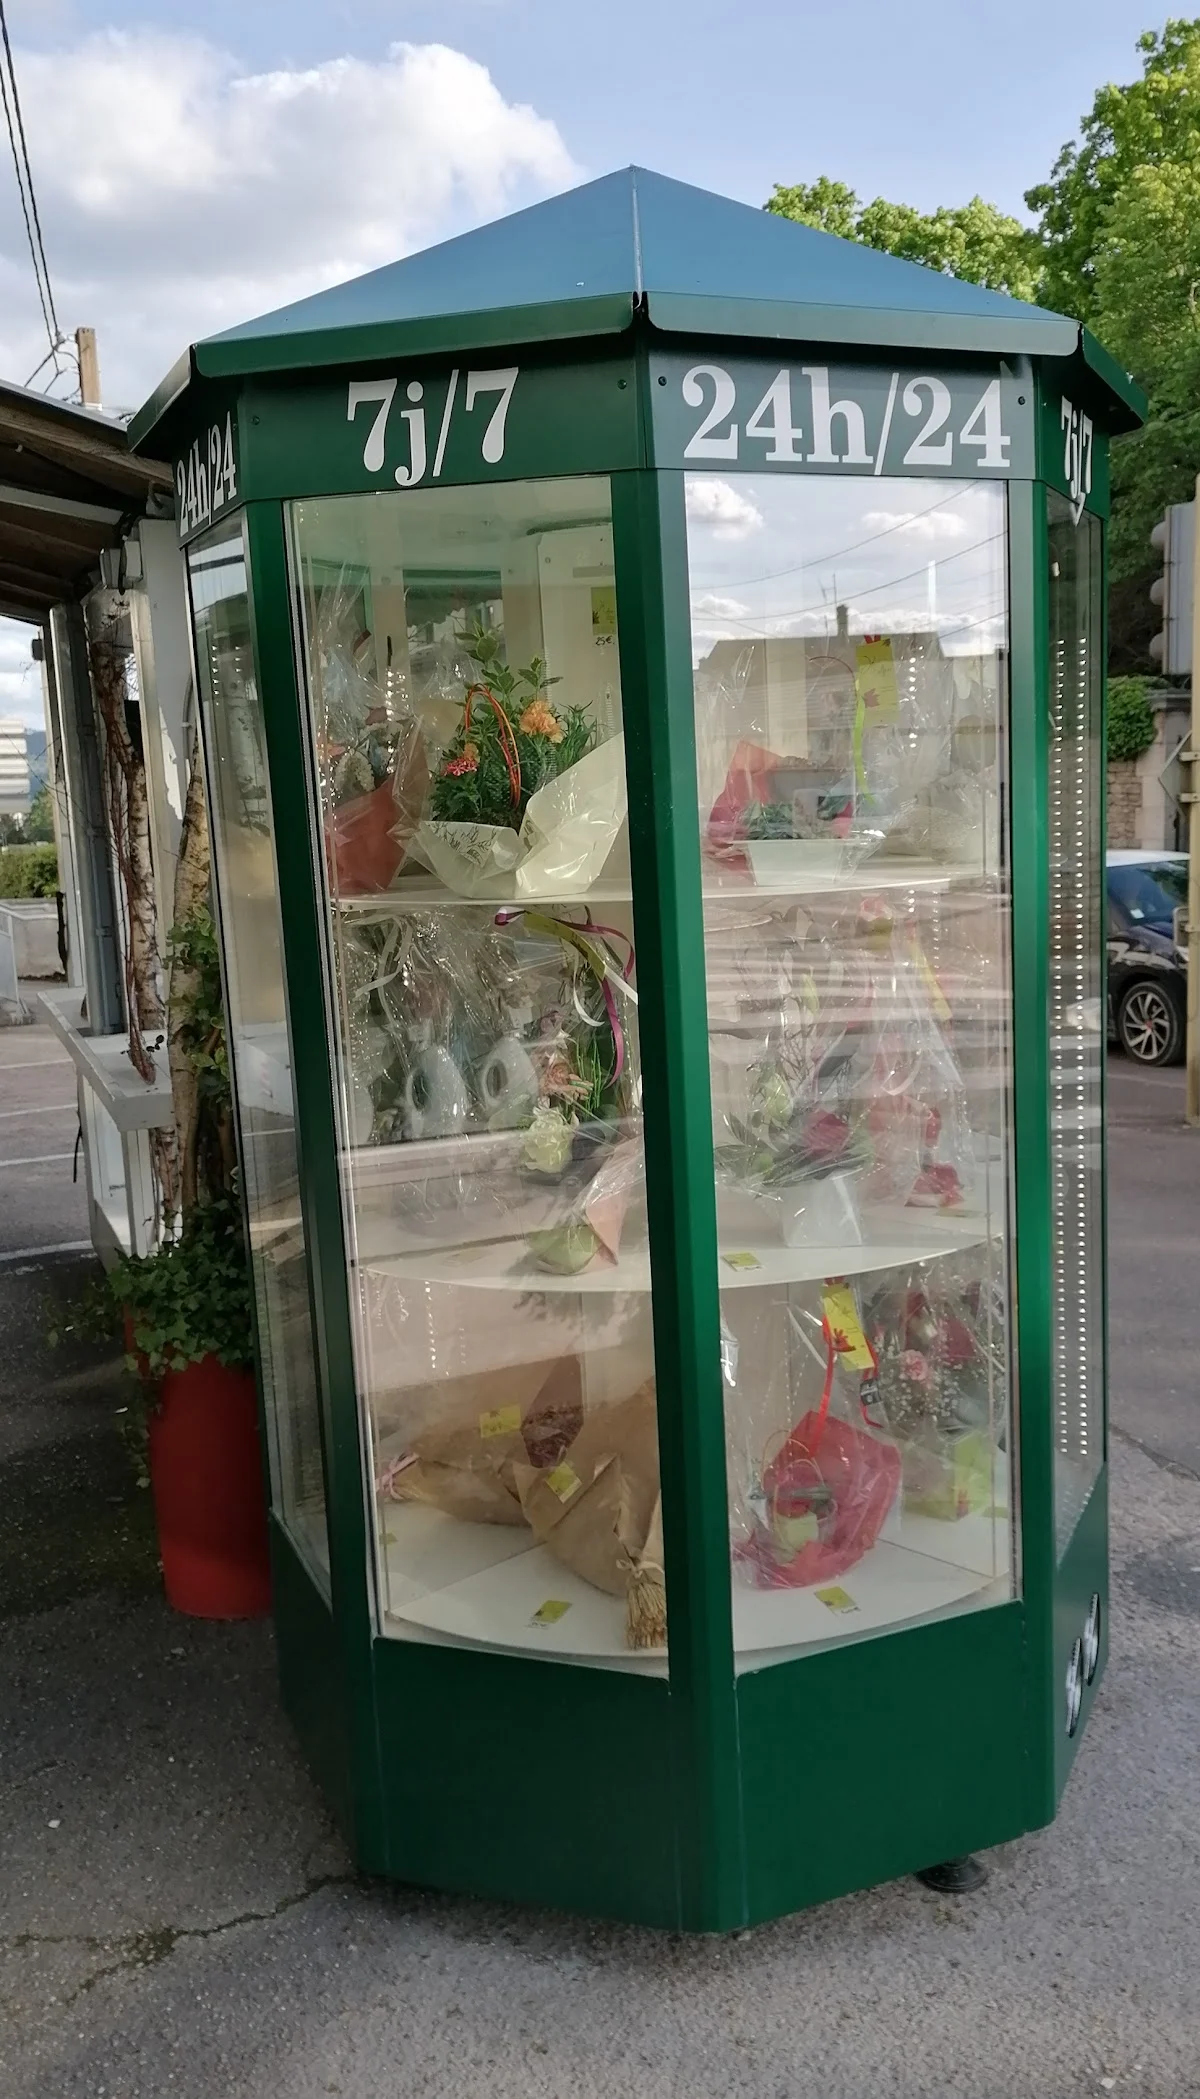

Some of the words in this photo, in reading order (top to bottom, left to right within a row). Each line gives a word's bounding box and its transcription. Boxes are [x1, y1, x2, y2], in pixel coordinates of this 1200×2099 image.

[176, 410, 237, 538] 24h/24
[347, 367, 519, 487] 7j/7
[682, 364, 1012, 476] 24h/24
[1061, 395, 1093, 500] 7j/7
